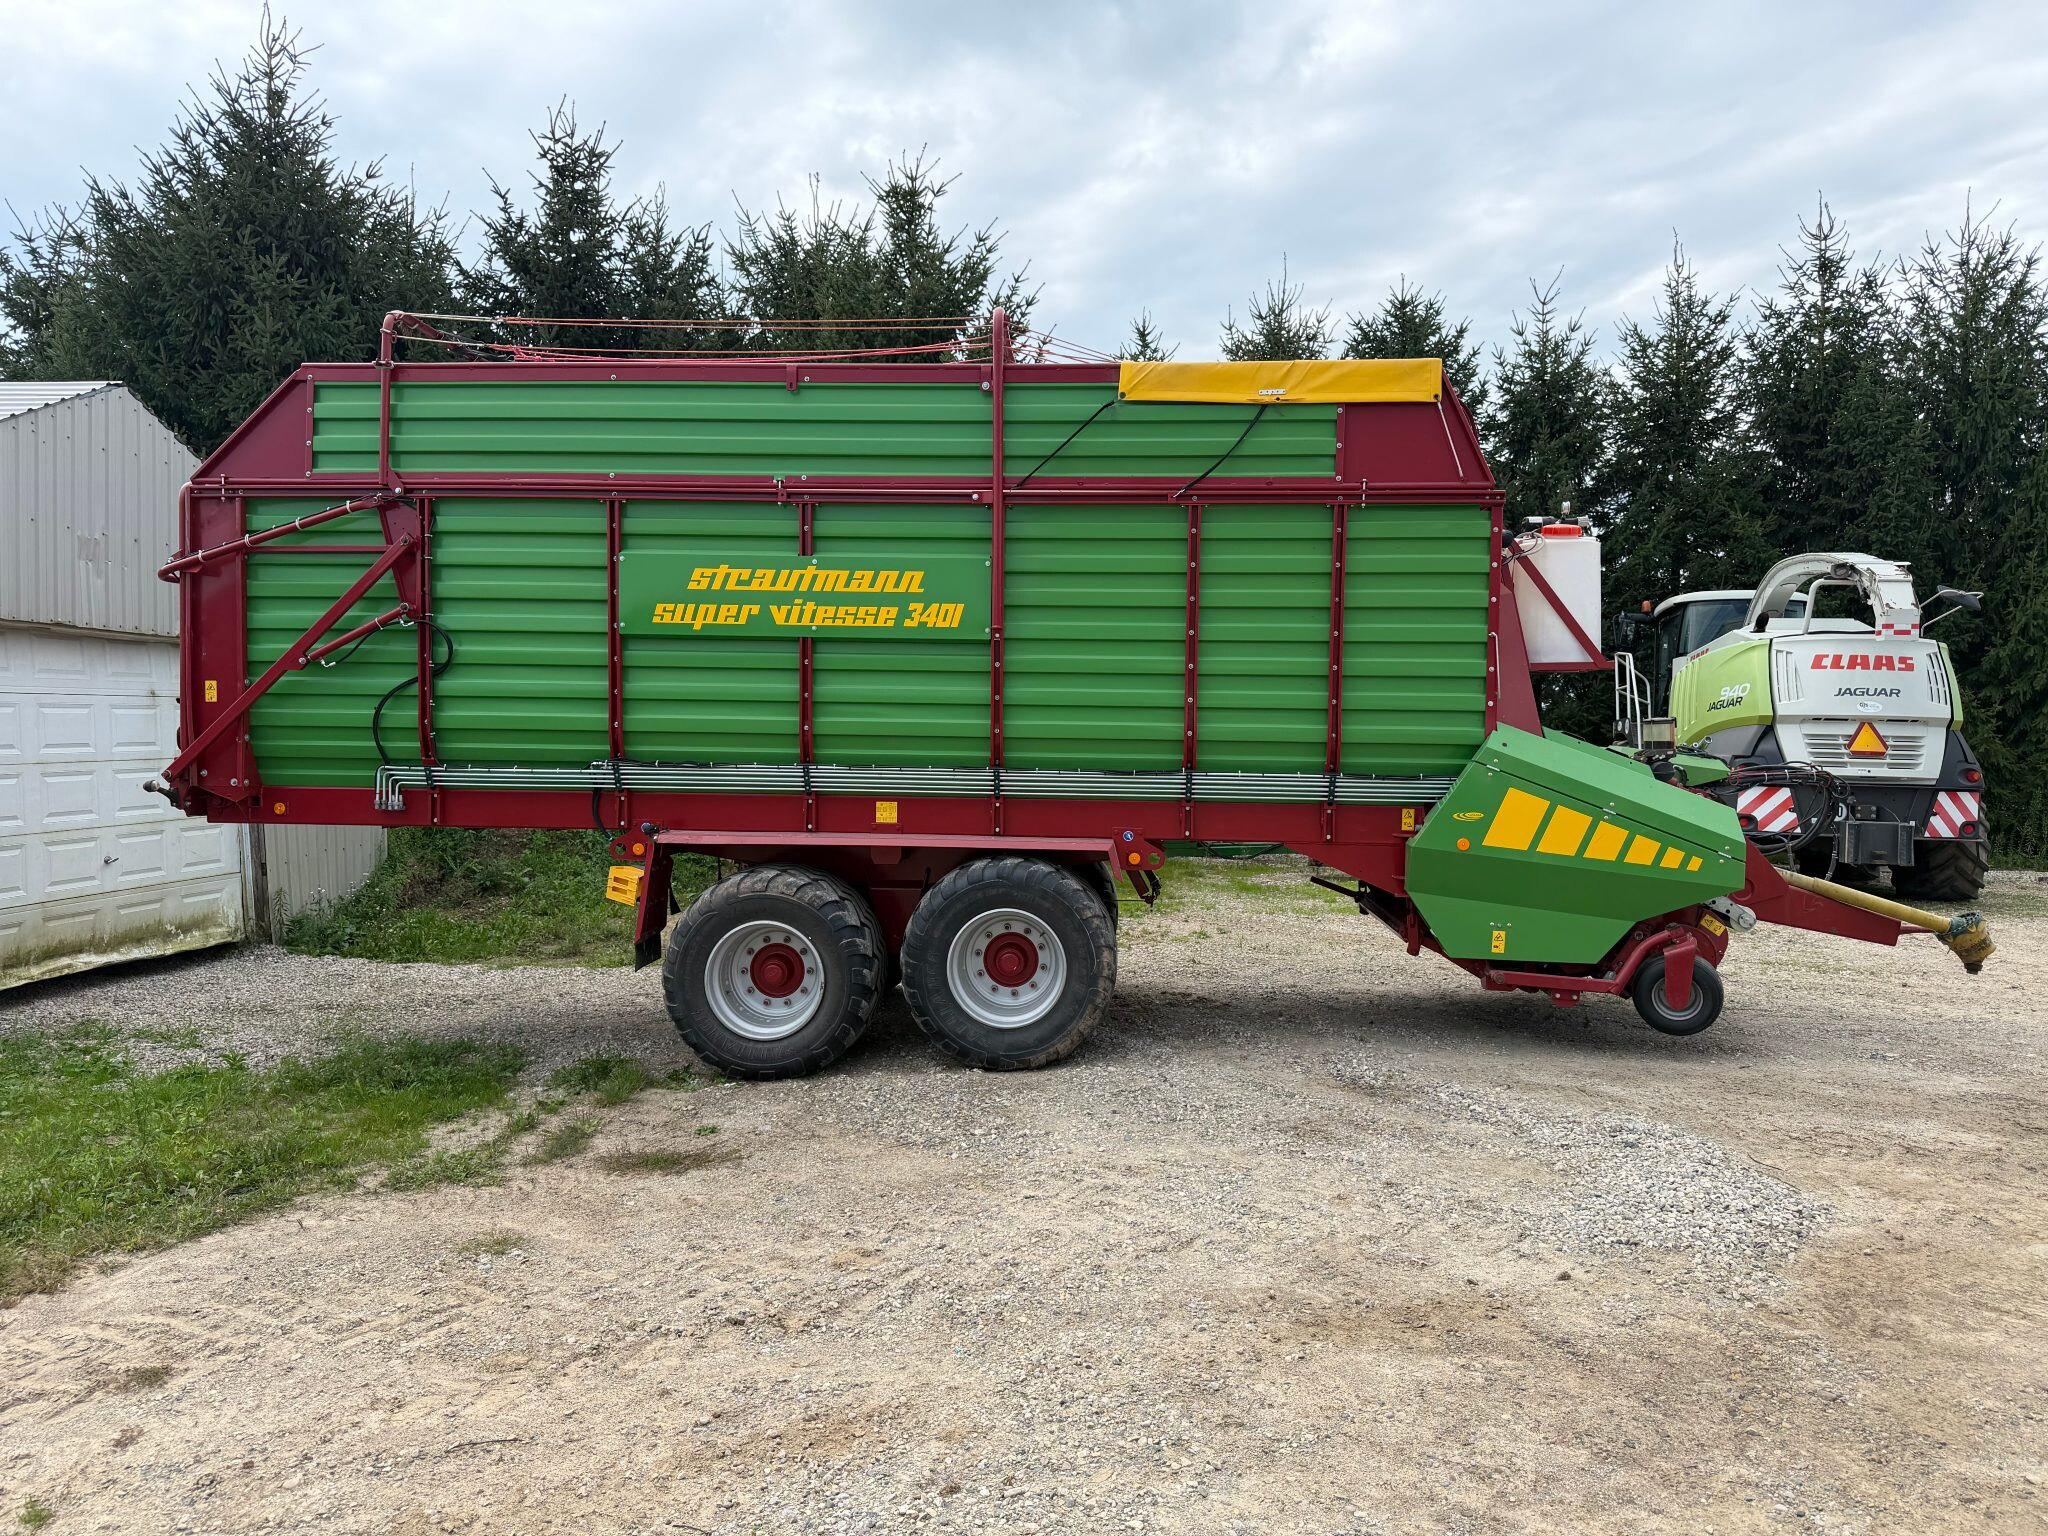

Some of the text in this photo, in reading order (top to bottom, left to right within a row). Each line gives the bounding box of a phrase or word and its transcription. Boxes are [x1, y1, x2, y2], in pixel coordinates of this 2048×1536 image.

[687, 565, 924, 593] strautmann
[652, 599, 964, 630] super vitesse 3401
[1810, 654, 1915, 672] CLAAS
[1720, 683, 1751, 700] 940
[1833, 687, 1902, 698] JAGUAR
[1707, 696, 1743, 712] JAGUAR
